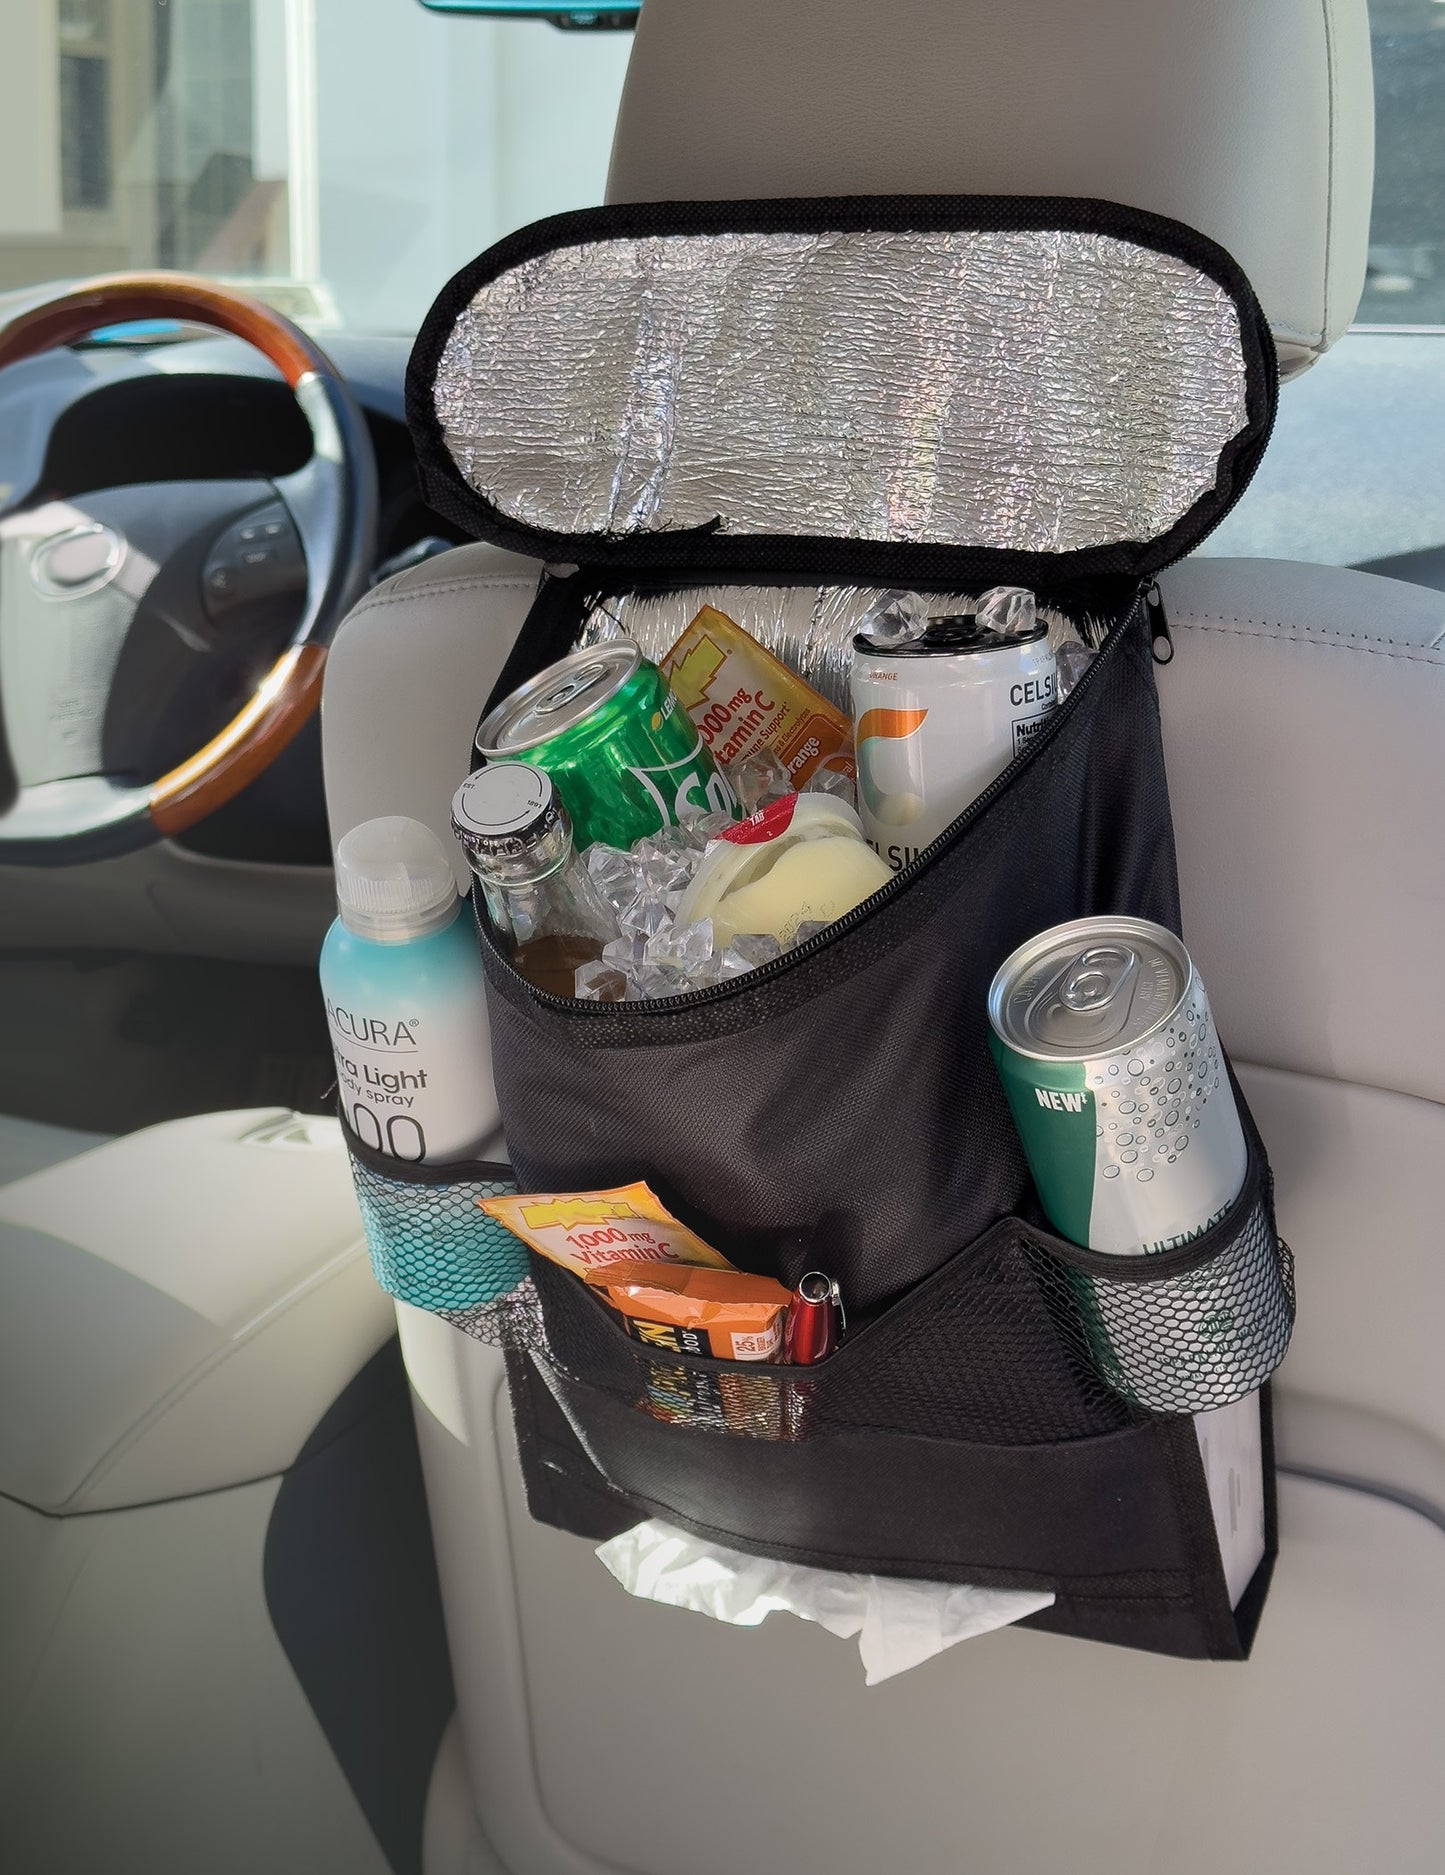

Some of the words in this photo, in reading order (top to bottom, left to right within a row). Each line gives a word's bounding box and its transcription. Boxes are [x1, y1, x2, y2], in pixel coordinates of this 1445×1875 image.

[727, 687, 753, 711] mg
[713, 709, 765, 766] tamin
[754, 690, 775, 711] C
[786, 735, 821, 775] range
[363, 1063, 428, 1094] Light
[366, 1088, 415, 1109] spray
[346, 1102, 427, 1164] 00
[565, 1227, 627, 1250] 1,000
[628, 1231, 656, 1244] mg
[656, 1242, 681, 1259] C
